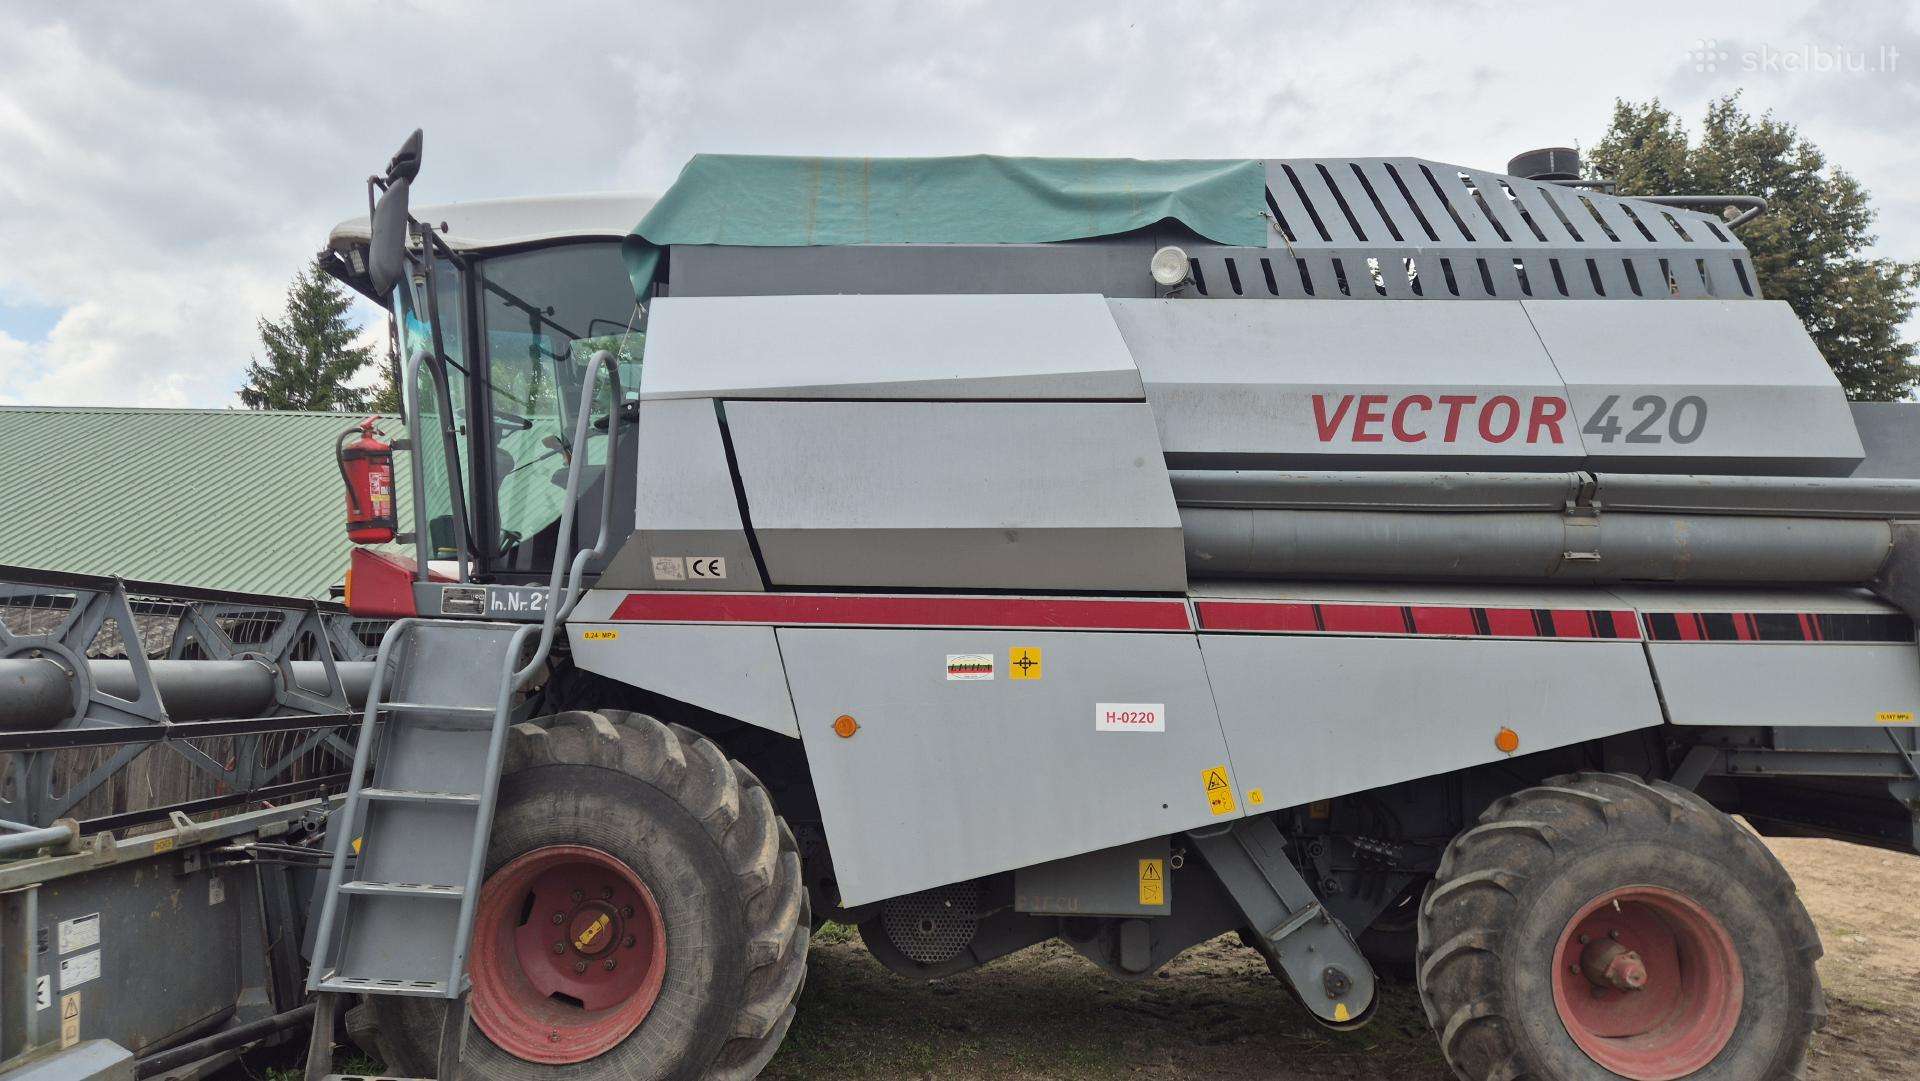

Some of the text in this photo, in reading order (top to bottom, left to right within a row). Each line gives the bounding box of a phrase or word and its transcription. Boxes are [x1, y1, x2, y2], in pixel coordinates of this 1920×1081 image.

[1311, 394, 1709, 445] VECTOR 420
[692, 559, 721, 577] CE
[1106, 711, 1155, 724] H-0220
